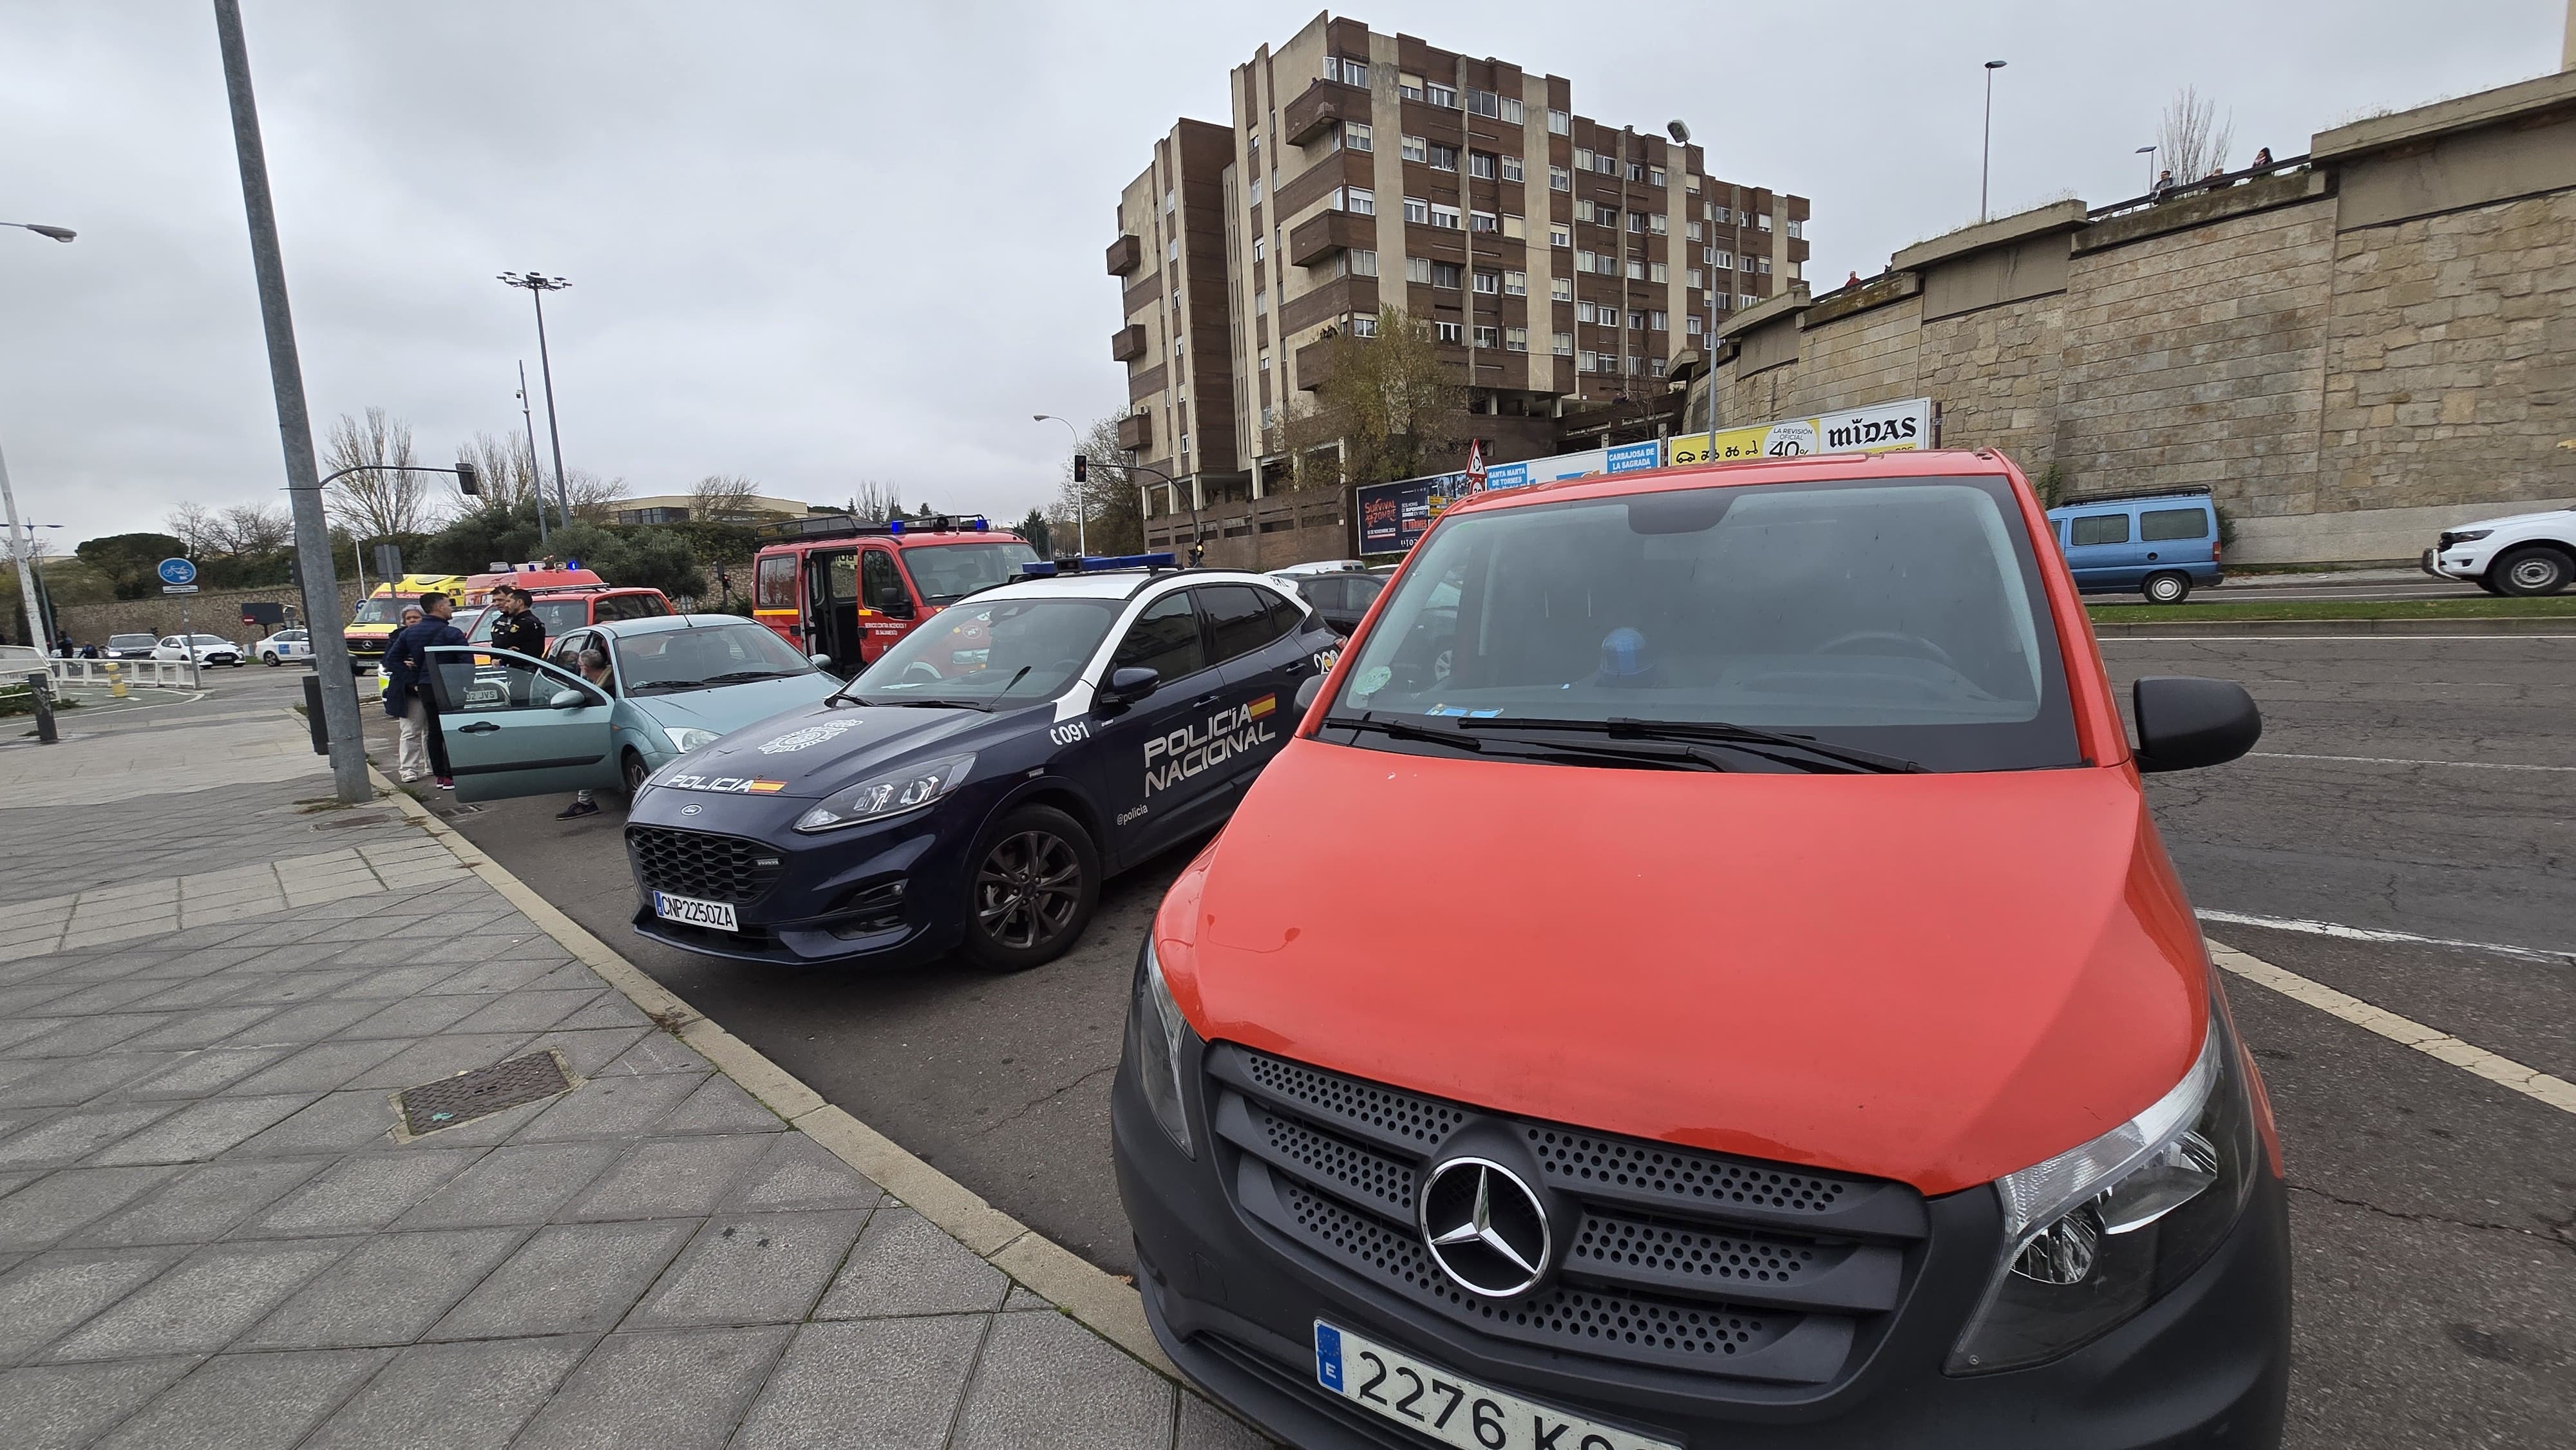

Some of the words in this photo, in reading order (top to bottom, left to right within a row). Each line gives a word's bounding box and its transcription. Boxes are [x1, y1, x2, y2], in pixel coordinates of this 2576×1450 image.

[1828, 417, 1917, 447] MIDAS
[1609, 449, 1645, 462] CARBAJOSA
[1622, 458, 1651, 469] SAGRADA
[1489, 470, 1506, 478] SANTA
[1507, 467, 1526, 476] MARTA
[1501, 476, 1522, 485] TORMES
[1365, 500, 1396, 514] SURVIVAL
[1373, 509, 1396, 523] ZOMBIE
[1058, 721, 1090, 743] 091
[1145, 722, 1276, 798] NACIONAL
[664, 775, 754, 793] POLICIA
[1117, 804, 1148, 825] @policia
[661, 896, 734, 927] CNP2250ZA
[1325, 1362, 1336, 1379] E
[1359, 1351, 1506, 1450] 2276
